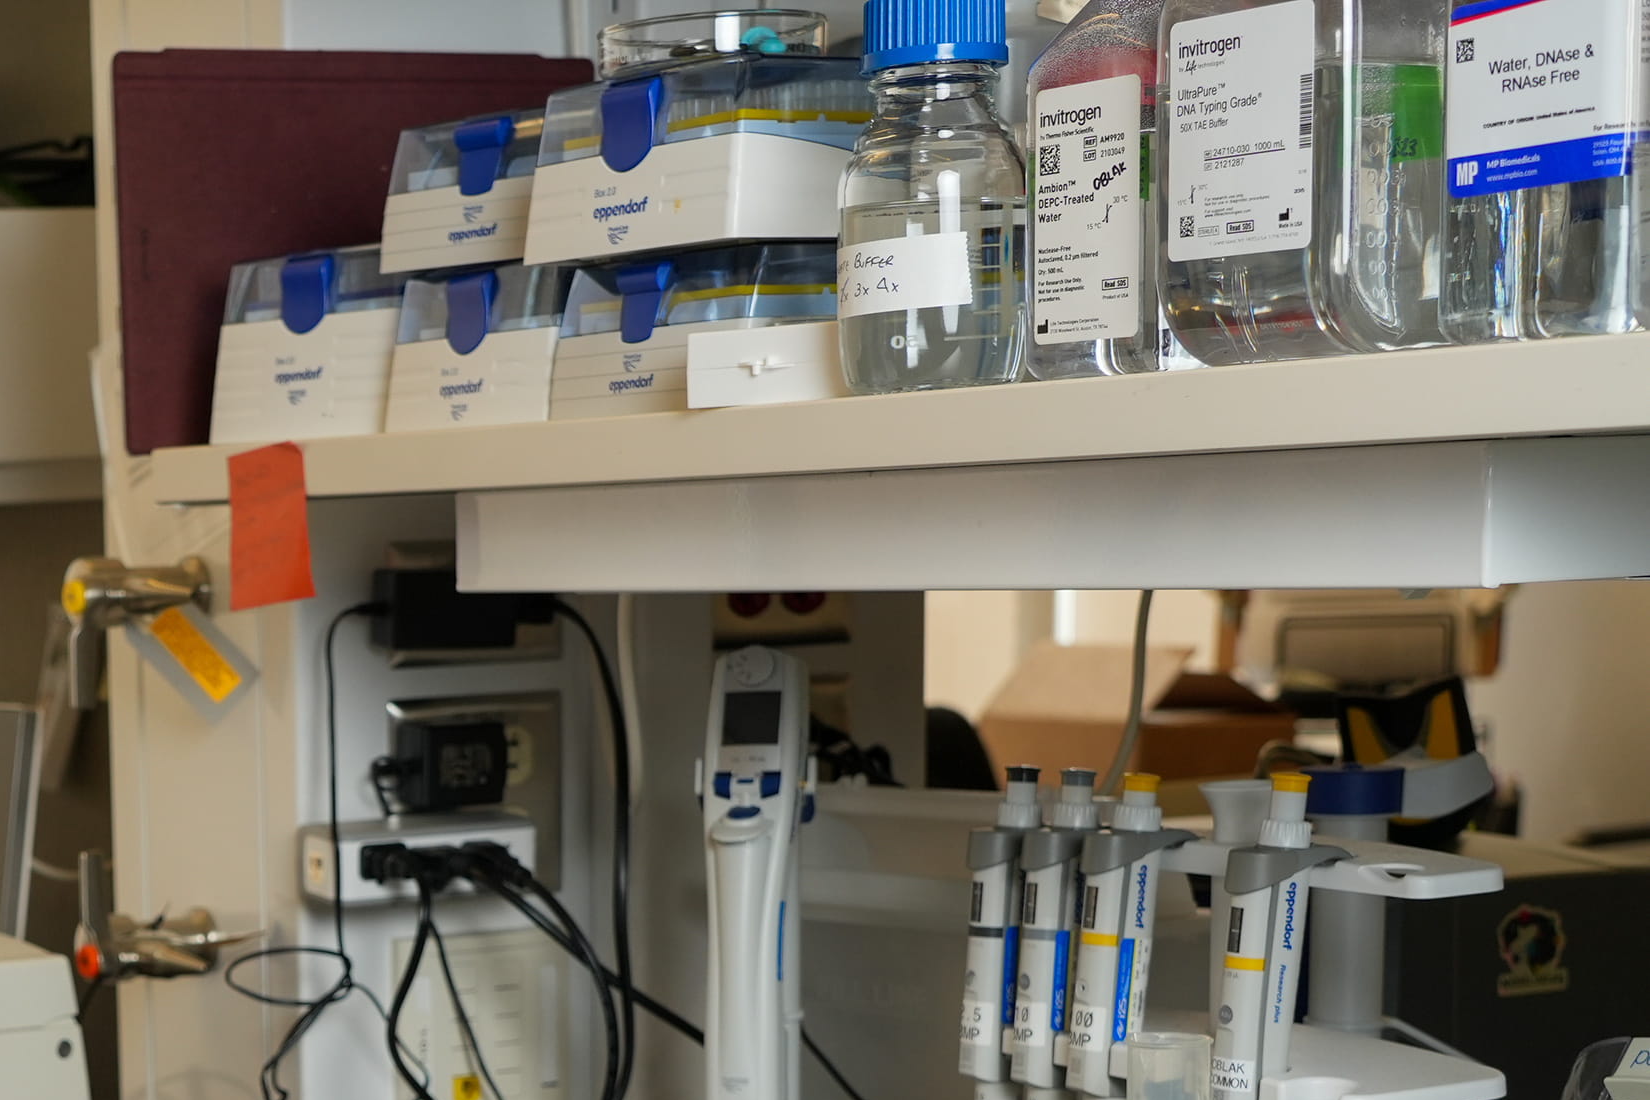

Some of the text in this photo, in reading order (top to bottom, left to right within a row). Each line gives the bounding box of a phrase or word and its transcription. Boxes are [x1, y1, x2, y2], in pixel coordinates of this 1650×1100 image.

[1178, 36, 1241, 59] invitrogen
[1488, 44, 1594, 76] Water, DNAse &
[1502, 68, 1580, 94] RNAse Free
[1040, 105, 1102, 128] invitrogen
[1177, 104, 1196, 117] DNA
[1199, 100, 1228, 116] Typing
[1180, 118, 1229, 133] 50X TAE Buffer
[1100, 133, 1125, 144] AM9920
[1254, 140, 1272, 150] 1000
[1272, 140, 1284, 149] mL
[1214, 158, 1244, 170] 2121287
[1456, 153, 1540, 187] MP MP Biomedicals
[593, 196, 648, 222] eppendorf
[1038, 192, 1094, 210] DEPC-Treated
[1038, 213, 1062, 224] Water
[608, 373, 654, 394] eppendorf
[1135, 864, 1148, 928] eppendorf
[1282, 881, 1298, 952] eppendorf
[1273, 964, 1287, 1024] Research plus
